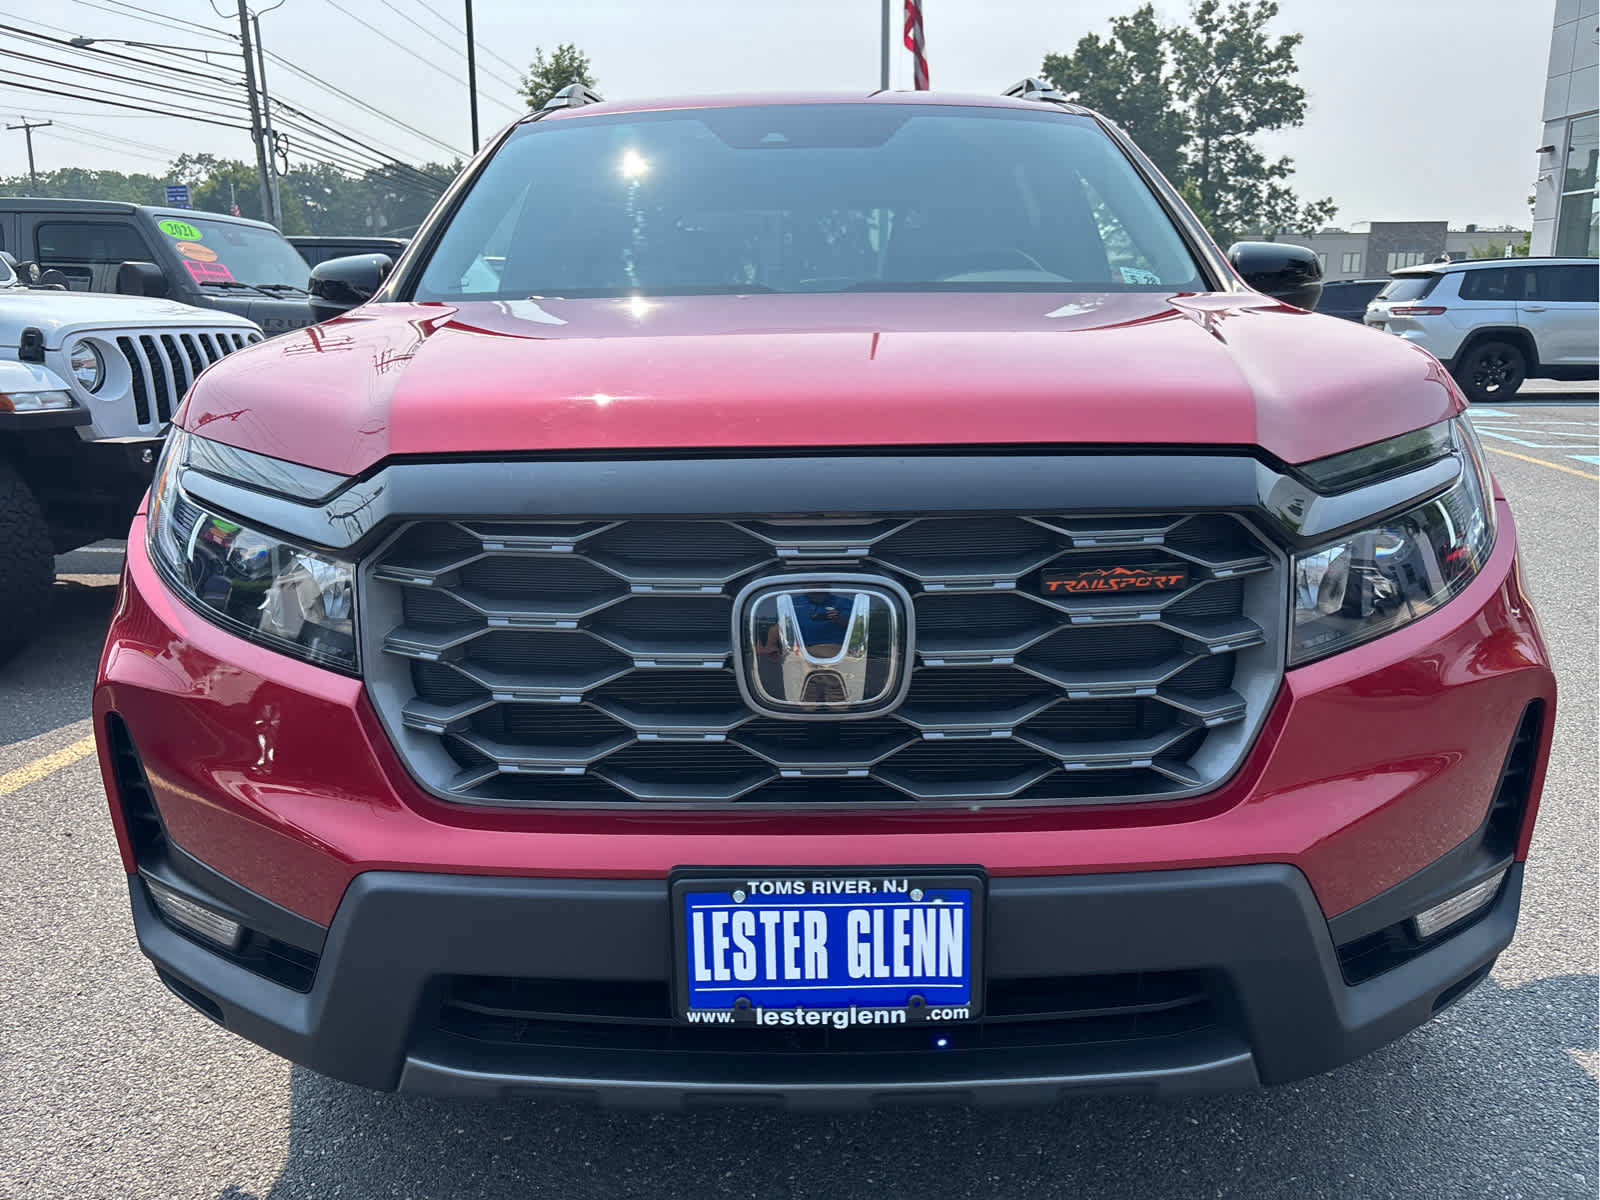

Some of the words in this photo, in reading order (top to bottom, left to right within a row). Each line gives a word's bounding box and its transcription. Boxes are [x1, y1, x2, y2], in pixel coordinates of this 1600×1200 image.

[168, 223, 194, 237] 2021
[1046, 575, 1184, 592] TRAILSPORT
[748, 881, 805, 895] TOMS
[812, 881, 877, 894] RIVER,
[883, 880, 909, 893] NJ
[692, 910, 828, 982] LESTER
[847, 908, 964, 978] GLENN
[687, 1011, 735, 1023] www.
[756, 1007, 906, 1029] lesterglenn
[925, 1006, 969, 1020] .com
